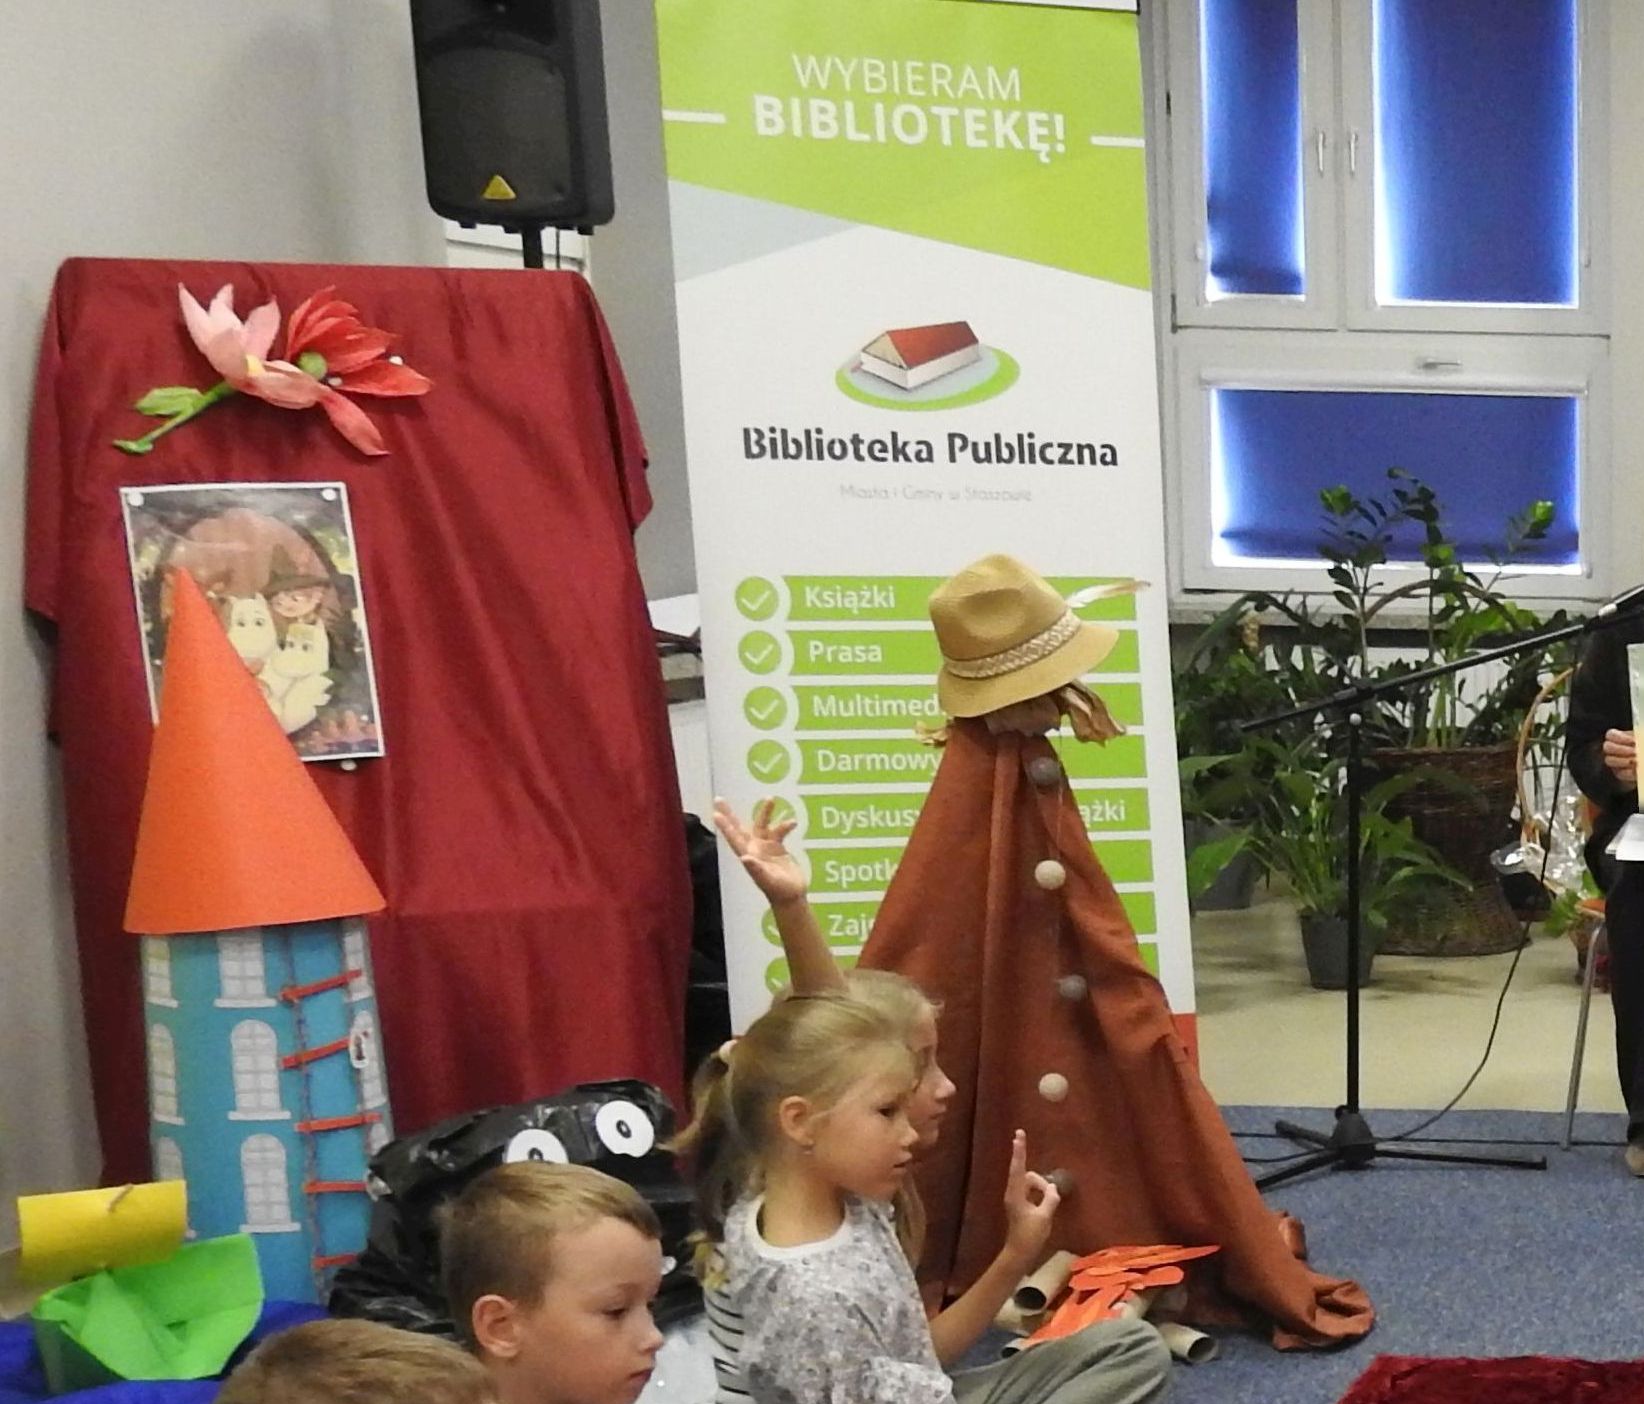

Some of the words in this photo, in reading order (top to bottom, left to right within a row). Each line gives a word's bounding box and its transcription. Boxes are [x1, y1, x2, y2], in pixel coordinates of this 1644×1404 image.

[791, 53, 1021, 102] WYBIERAM
[753, 94, 1066, 164] BIBLIOTEKĘ!
[742, 426, 935, 464] Biblioteka
[947, 432, 1119, 467] Publiczna
[805, 584, 896, 615] Książki
[809, 640, 882, 663] Prasa
[813, 693, 946, 718] Multimed
[1079, 799, 1126, 829] ążki
[828, 913, 876, 942] Zaj
